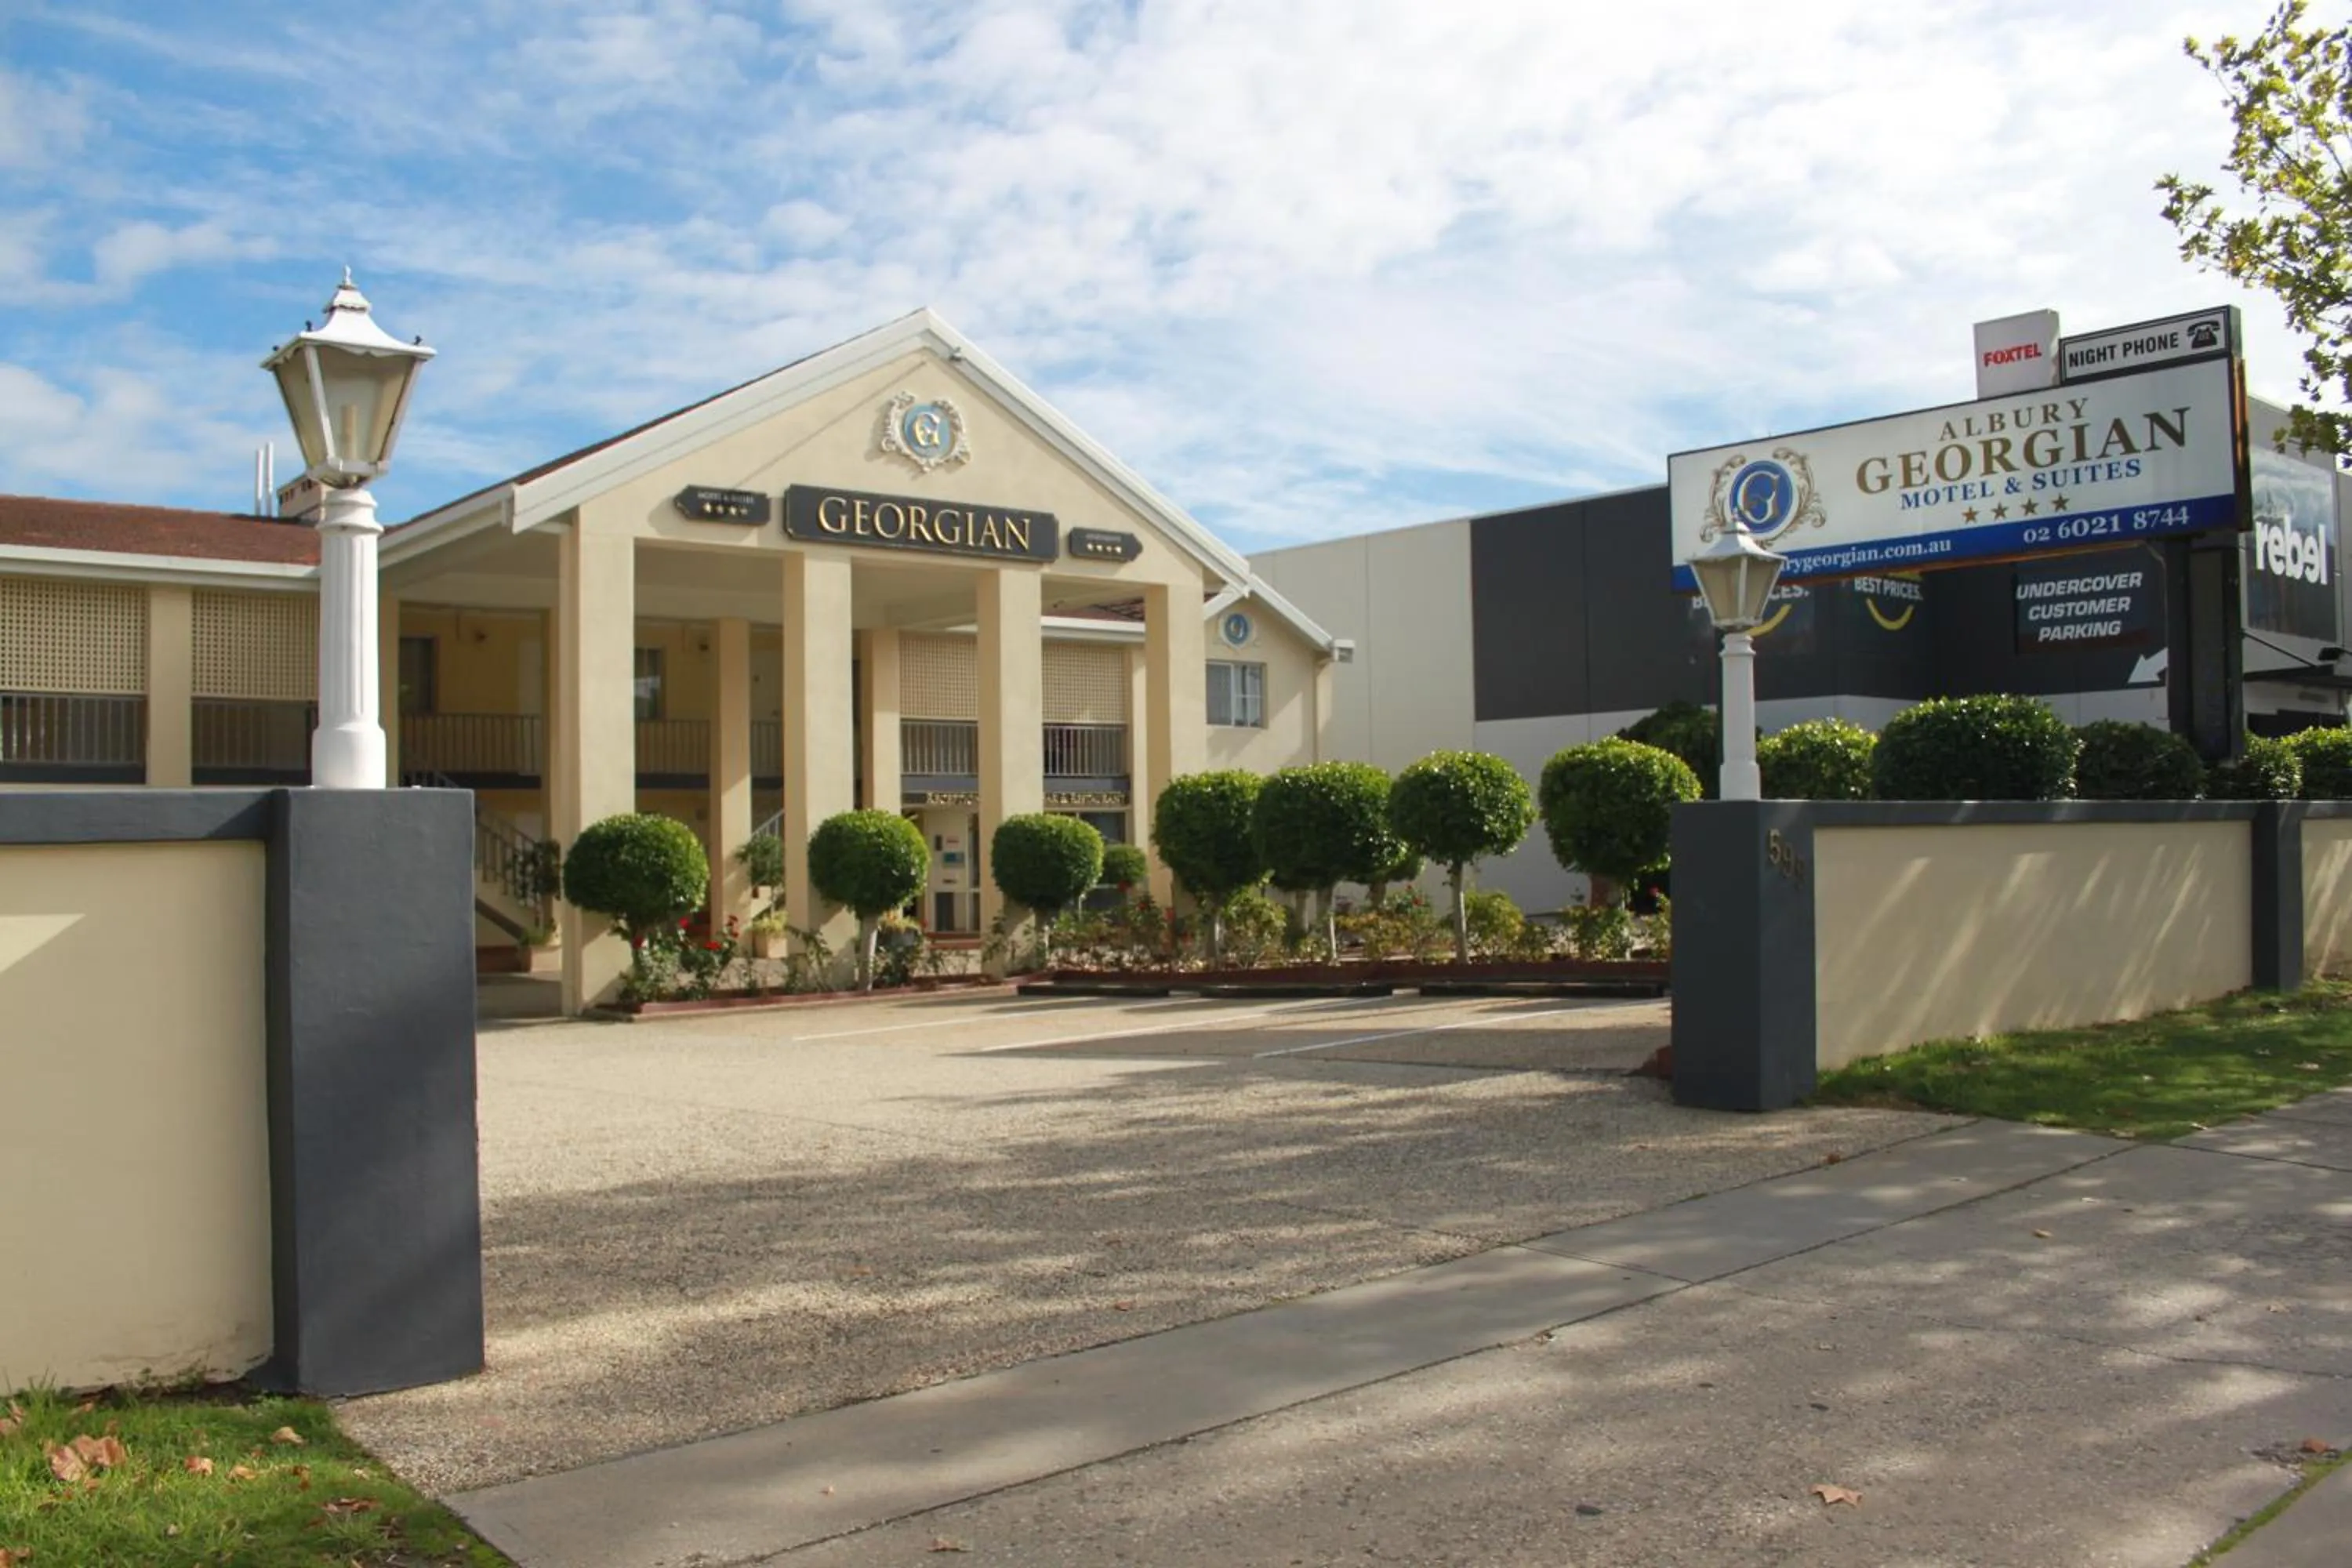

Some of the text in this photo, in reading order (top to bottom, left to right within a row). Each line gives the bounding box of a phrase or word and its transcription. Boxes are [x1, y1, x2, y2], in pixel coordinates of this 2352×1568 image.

[1982, 343, 2042, 367] FOXTEL
[2068, 332, 2179, 368] NIGHT PHONE
[1939, 397, 2089, 441] ALBURY
[1856, 406, 2192, 495] GEORGIAN
[1900, 458, 2142, 511] MOTEL & SUITES
[818, 496, 1031, 550] GEORGIAN
[2023, 506, 2190, 543] 02 6021 8744
[1781, 539, 1951, 575] rygeorgian.com.au
[2255, 513, 2328, 586] rebel
[1854, 577, 1882, 594] BEST
[2016, 572, 2143, 600] UNDERCOVER
[2028, 596, 2131, 620] CUSTOMER
[2038, 620, 2122, 642] PARKING
